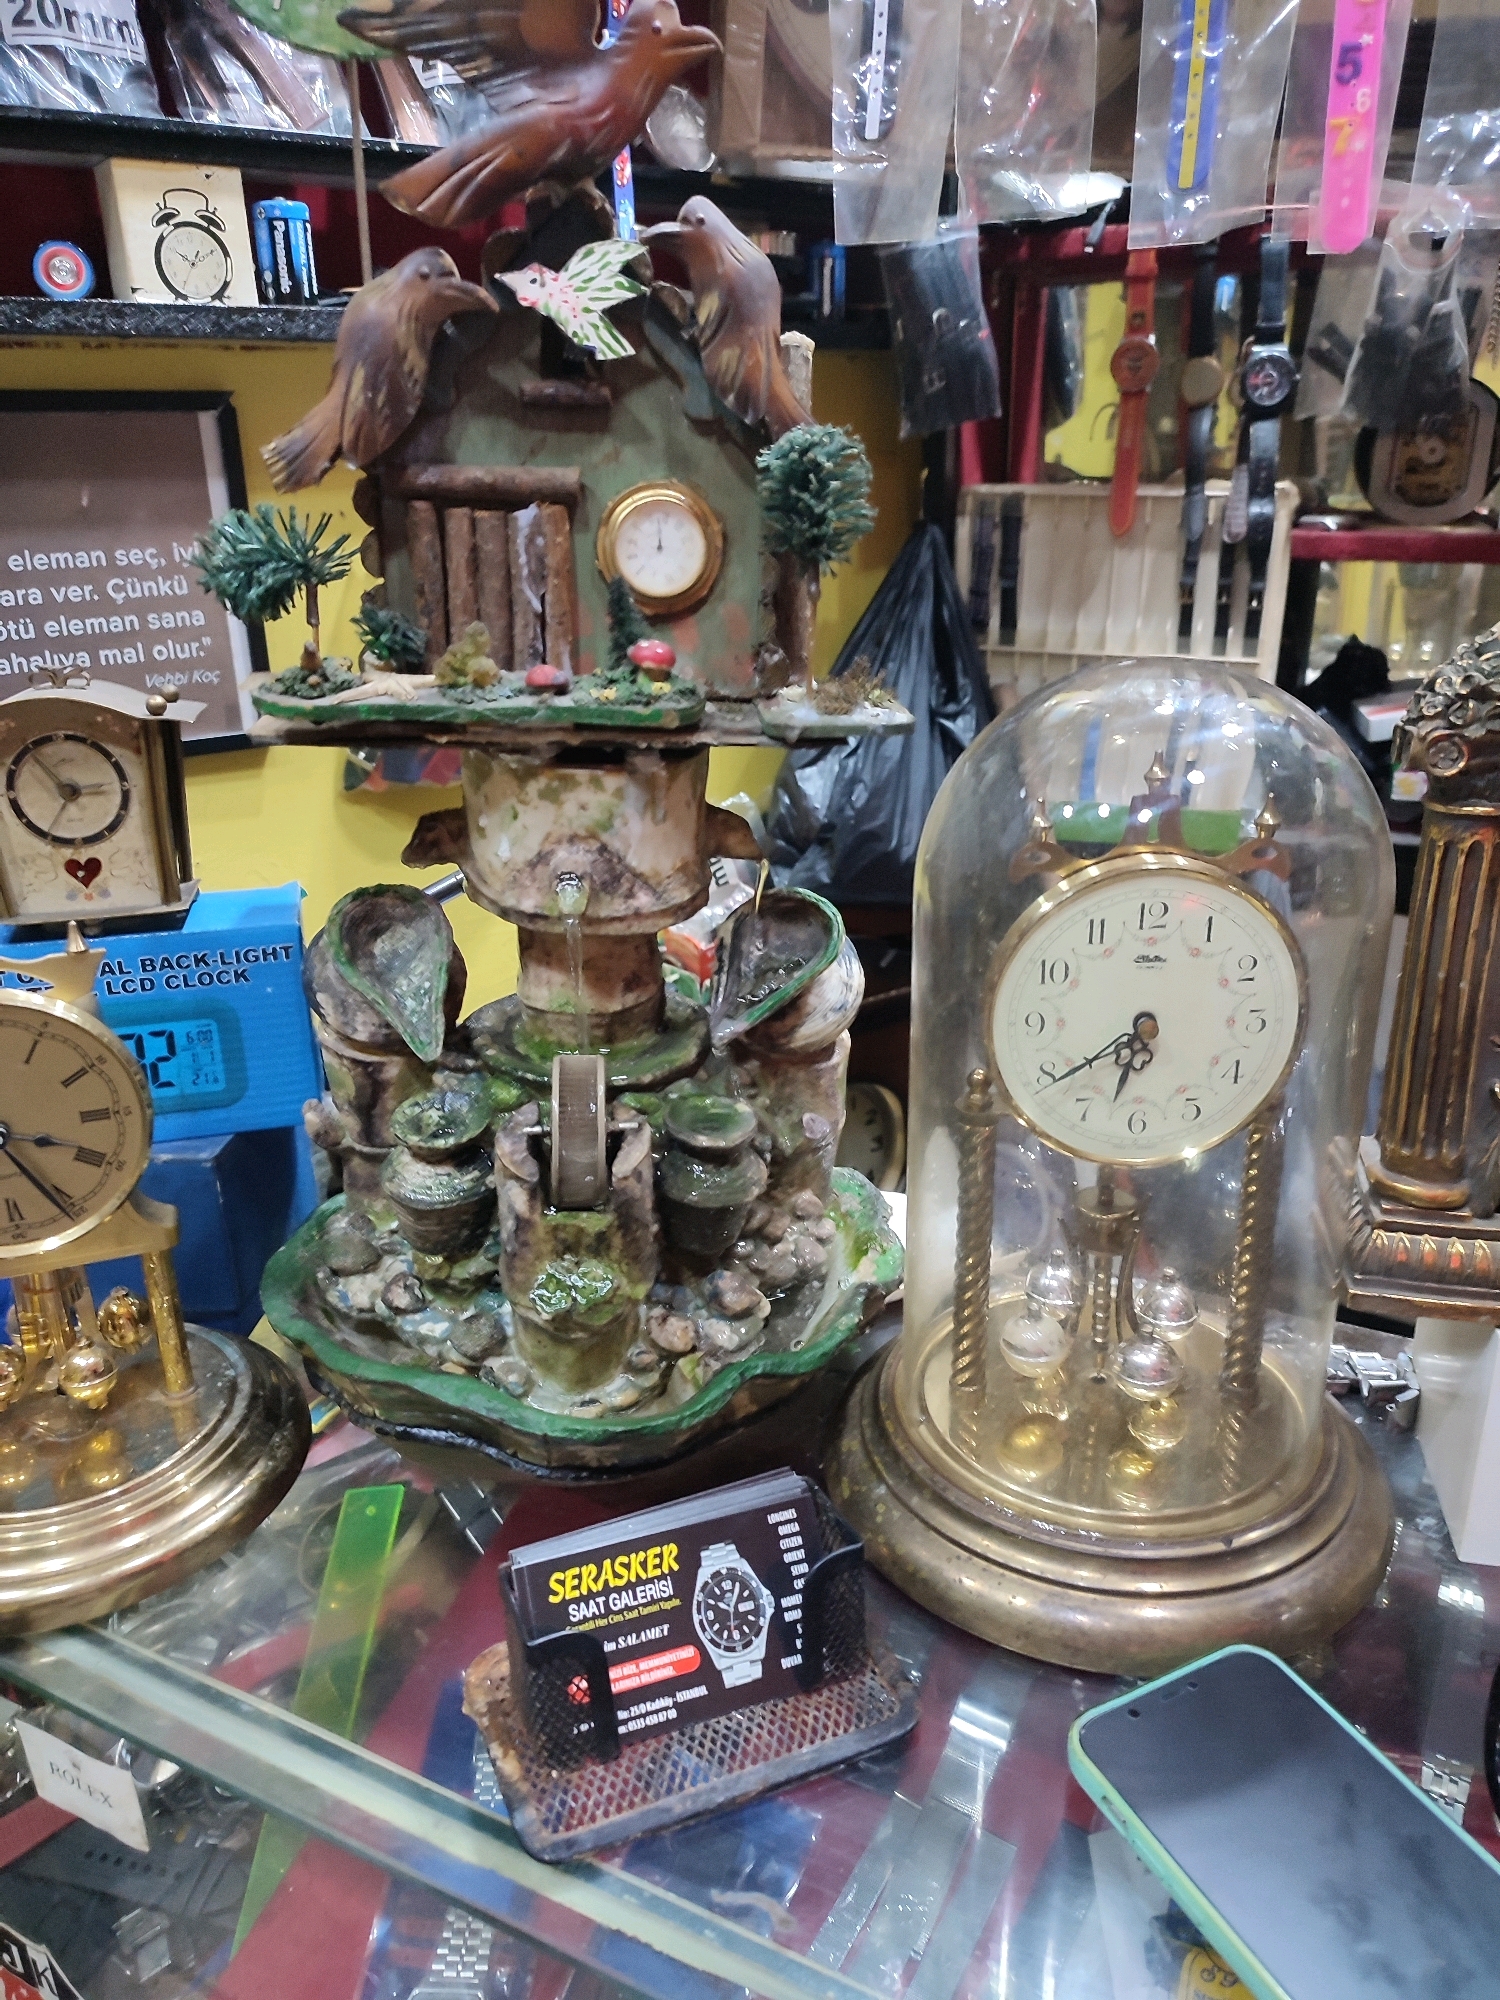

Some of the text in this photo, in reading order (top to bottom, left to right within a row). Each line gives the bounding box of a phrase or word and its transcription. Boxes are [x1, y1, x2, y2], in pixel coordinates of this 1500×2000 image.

[1336, 42, 1362, 84] 5
[1356, 88, 1371, 114] 6
[1330, 118, 1353, 157] 7
[273, 220, 293, 295] Panasonic
[8, 549, 106, 572] eleman
[115, 547, 167, 570] seç,
[50, 583, 99, 603] ver.
[106, 574, 189, 604] Çünkü
[44, 614, 140, 638] eleman
[147, 609, 206, 630] sana
[99, 642, 145, 666] mal
[152, 636, 212, 661] olur."
[193, 669, 221, 685] Koç
[1138, 901, 1169, 931] 12
[1204, 915, 1214, 943] 1
[1087, 918, 1106, 945] 11
[140, 945, 294, 974] BACK-LIGHT
[1040, 958, 1070, 985] 10
[1236, 954, 1258, 983] 2
[106, 968, 251, 996] LCD CLOCK
[1024, 1011, 1046, 1037] 9
[1245, 1009, 1267, 1034] 3
[1036, 1060, 1057, 1085] 8
[1220, 1058, 1244, 1085] 4
[1075, 1097, 1094, 1122] 7
[1127, 1110, 1147, 1136] 6
[1181, 1098, 1202, 1122] 5
[548, 1542, 680, 1604] SERASKER
[568, 1575, 674, 1622] SAAT GALERİSİ
